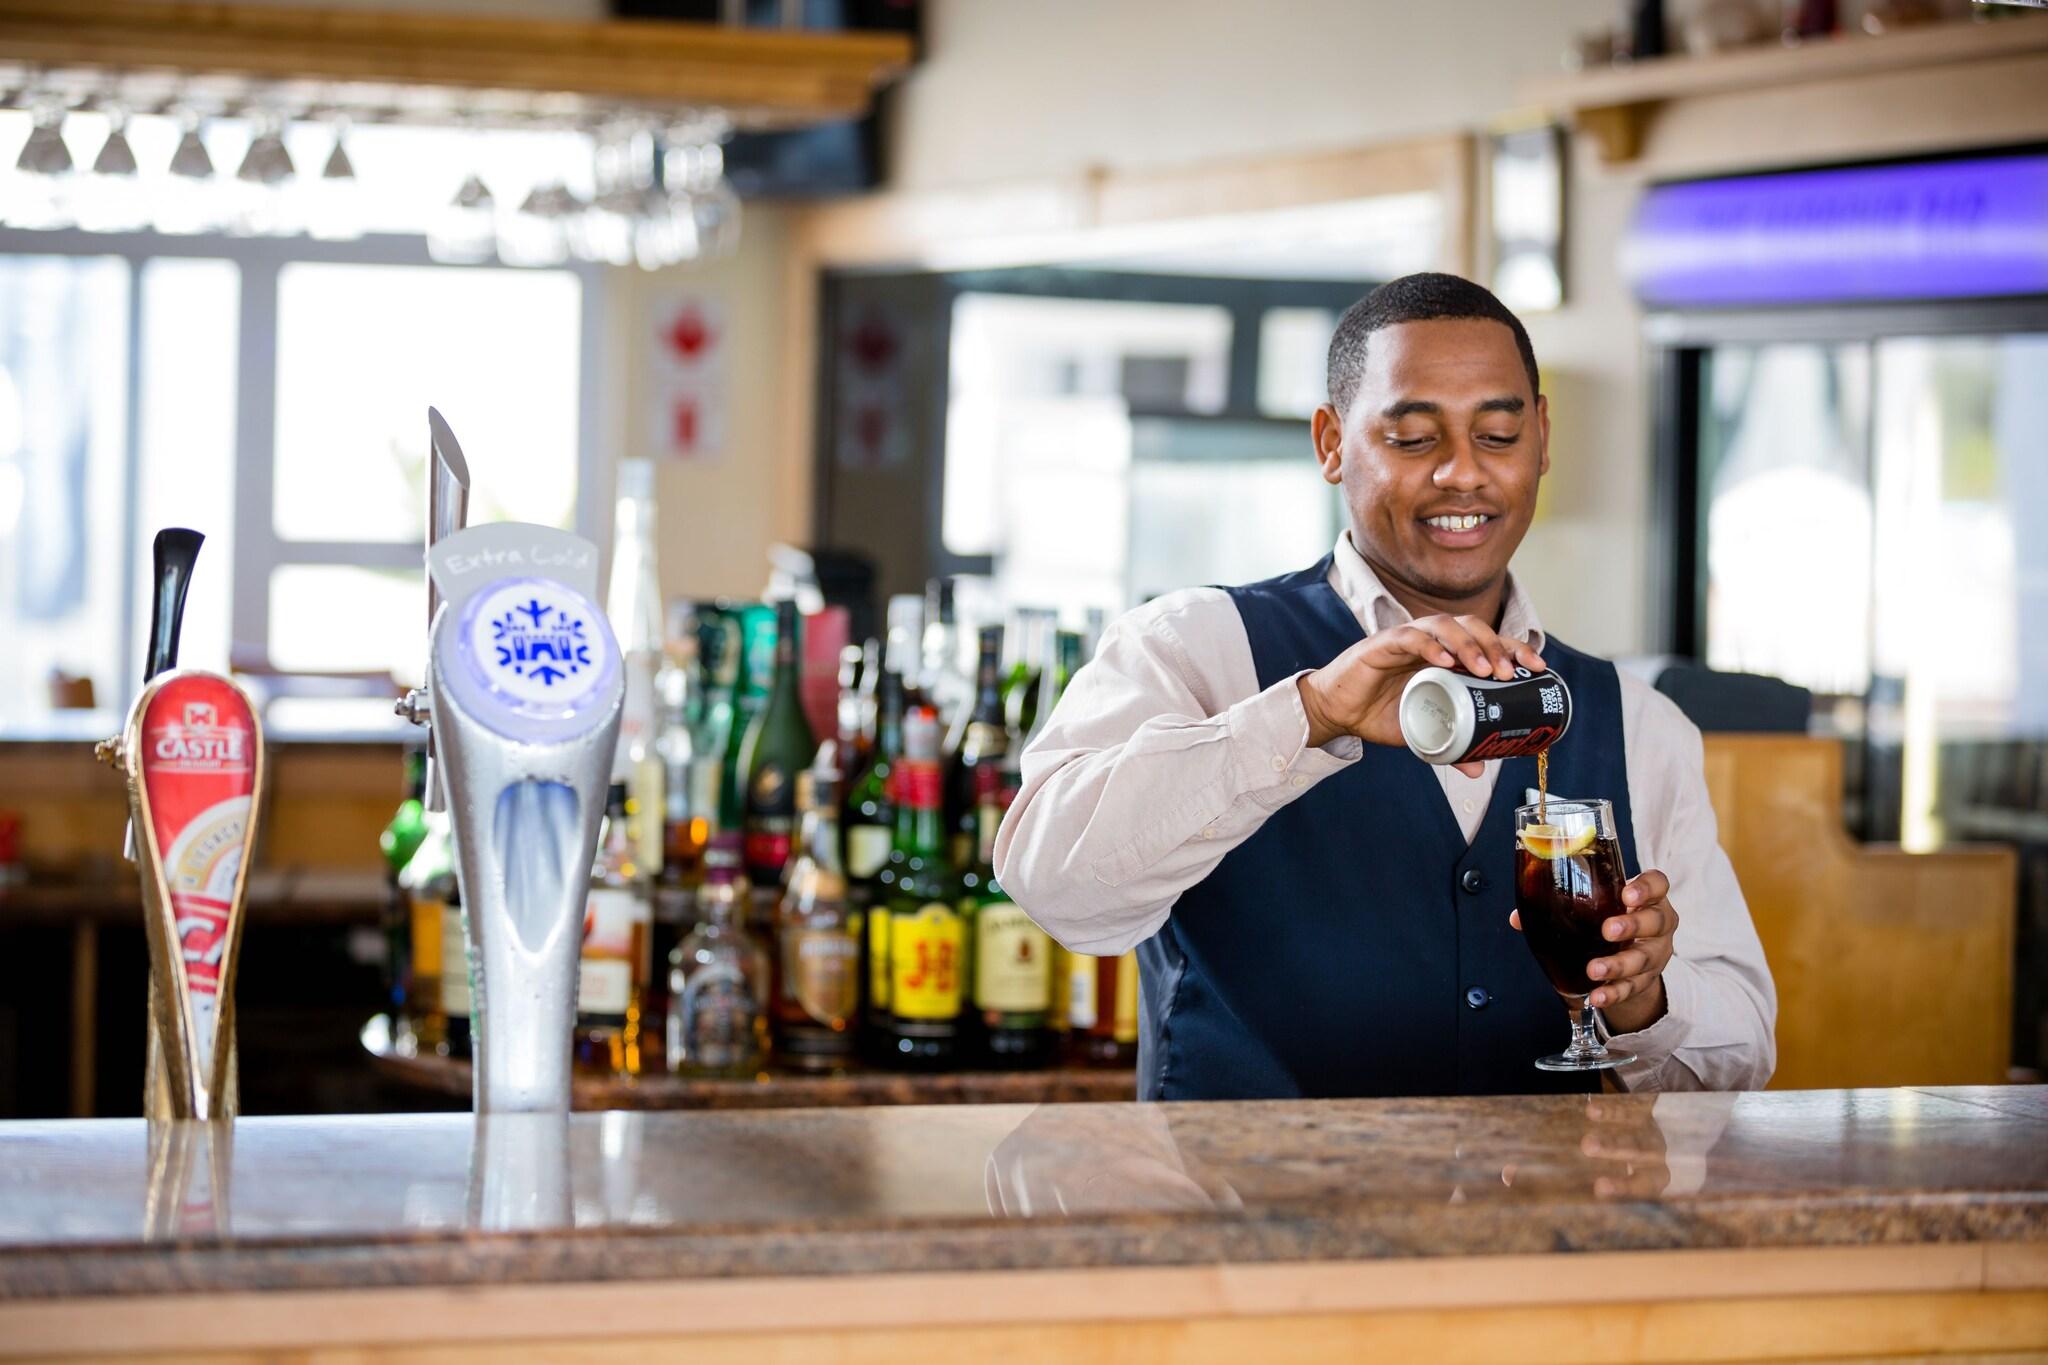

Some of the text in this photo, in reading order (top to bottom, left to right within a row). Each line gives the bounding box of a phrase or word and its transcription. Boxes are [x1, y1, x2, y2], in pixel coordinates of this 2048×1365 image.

[445, 548, 523, 575] Extra
[1472, 690, 1488, 722] 330 ml
[1538, 688, 1549, 714] SUGAR
[1549, 686, 1559, 714] TASTE
[1554, 684, 1564, 714] GREAT
[155, 738, 243, 760] CASTLE
